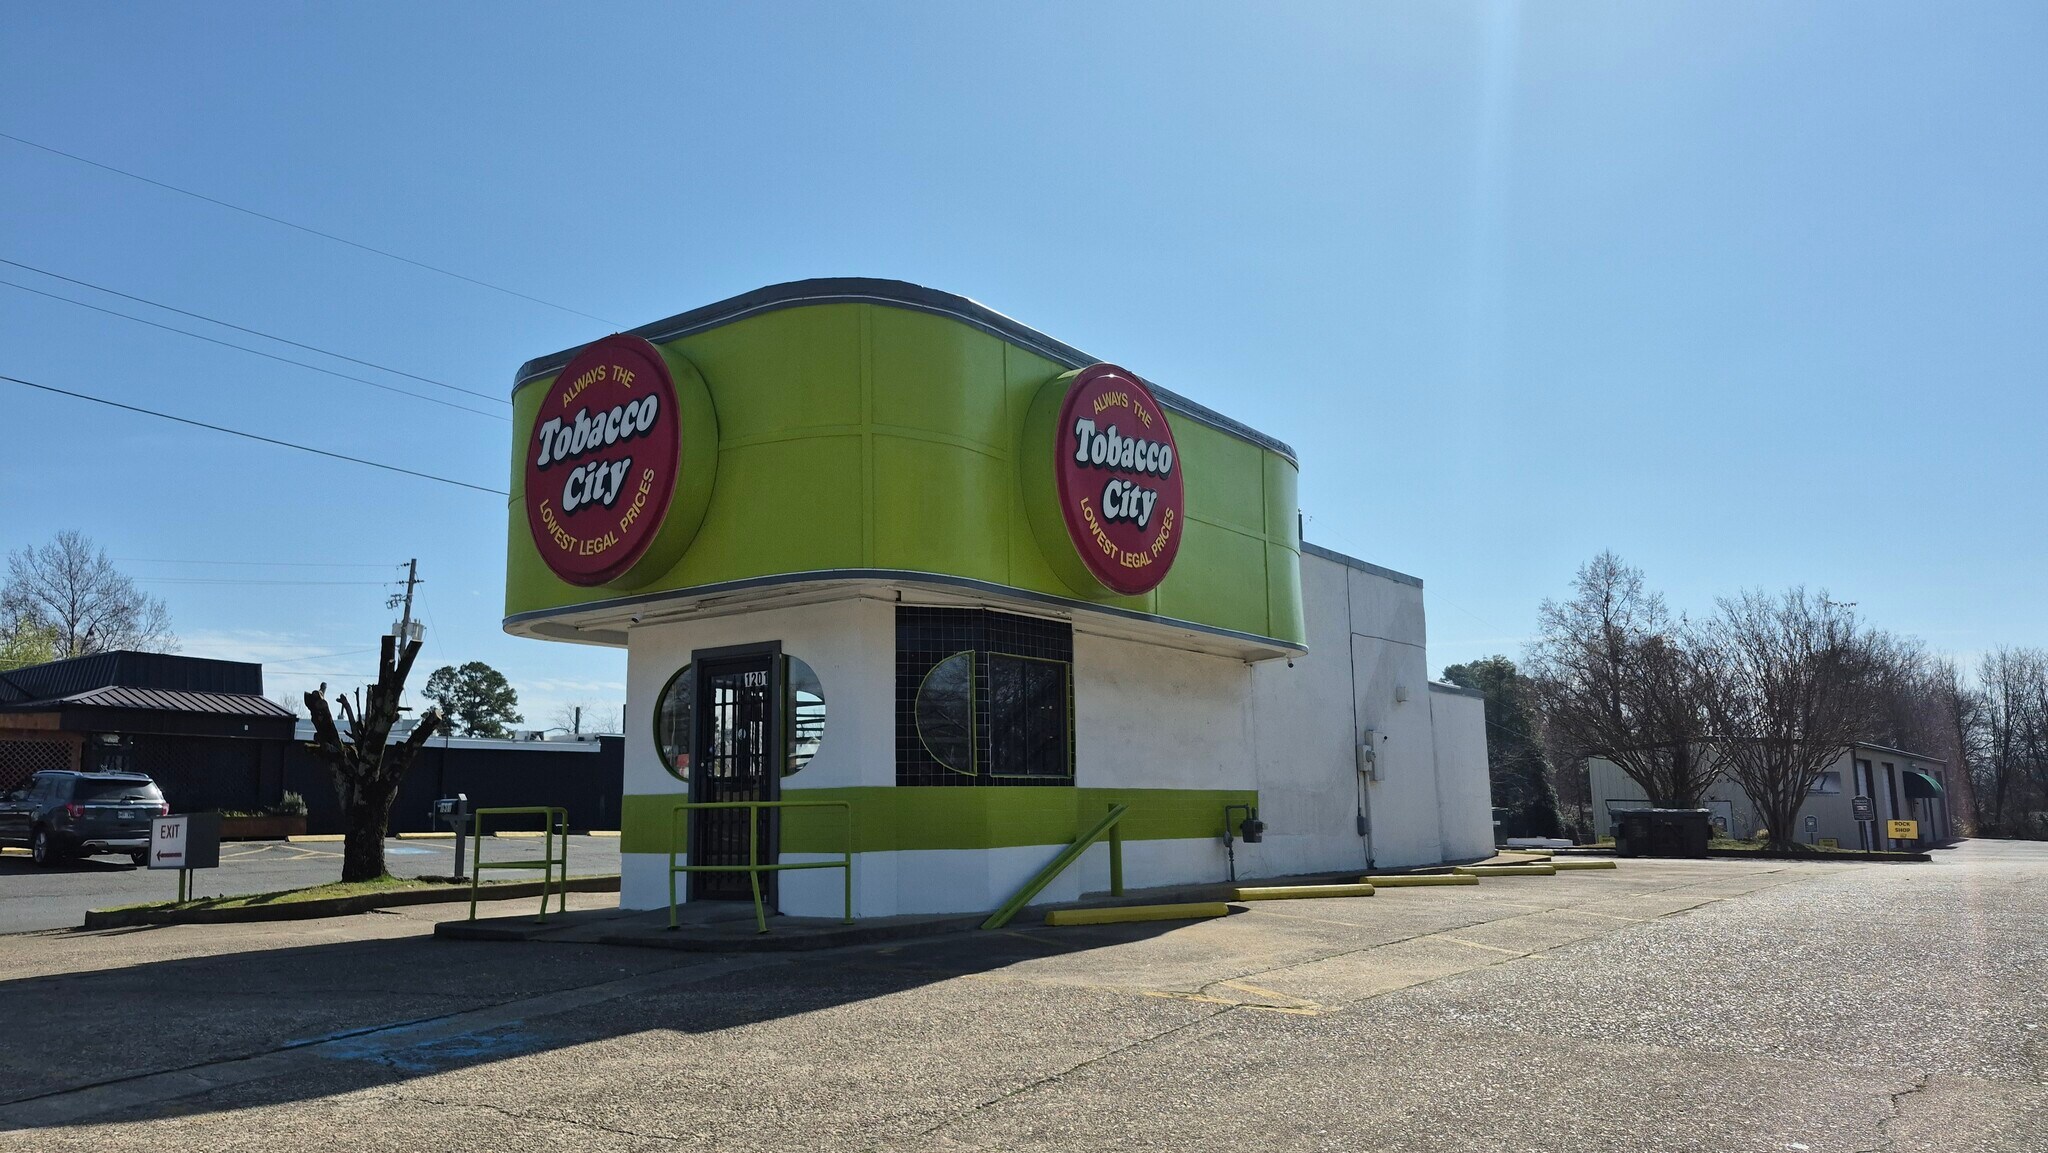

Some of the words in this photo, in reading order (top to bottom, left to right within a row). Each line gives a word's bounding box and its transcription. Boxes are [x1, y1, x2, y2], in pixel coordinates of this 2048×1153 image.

[562, 365, 606, 408] ALWAYS
[613, 364, 635, 388] THE
[1094, 391, 1128, 414] ALWAYS
[1133, 400, 1152, 430] THE
[537, 394, 658, 466] Tobacco
[1075, 417, 1173, 475] Tobacco
[539, 498, 578, 553] LOWEST
[579, 531, 619, 556] LEGAL
[619, 467, 655, 533] PRICES
[562, 457, 631, 513] City
[1102, 478, 1158, 528] City
[1080, 497, 1118, 560] LOWEST
[1120, 550, 1152, 569] LEGAL
[1151, 506, 1174, 558] PRICES
[745, 672, 767, 686] 1201
[160, 824, 180, 839] EXIT
